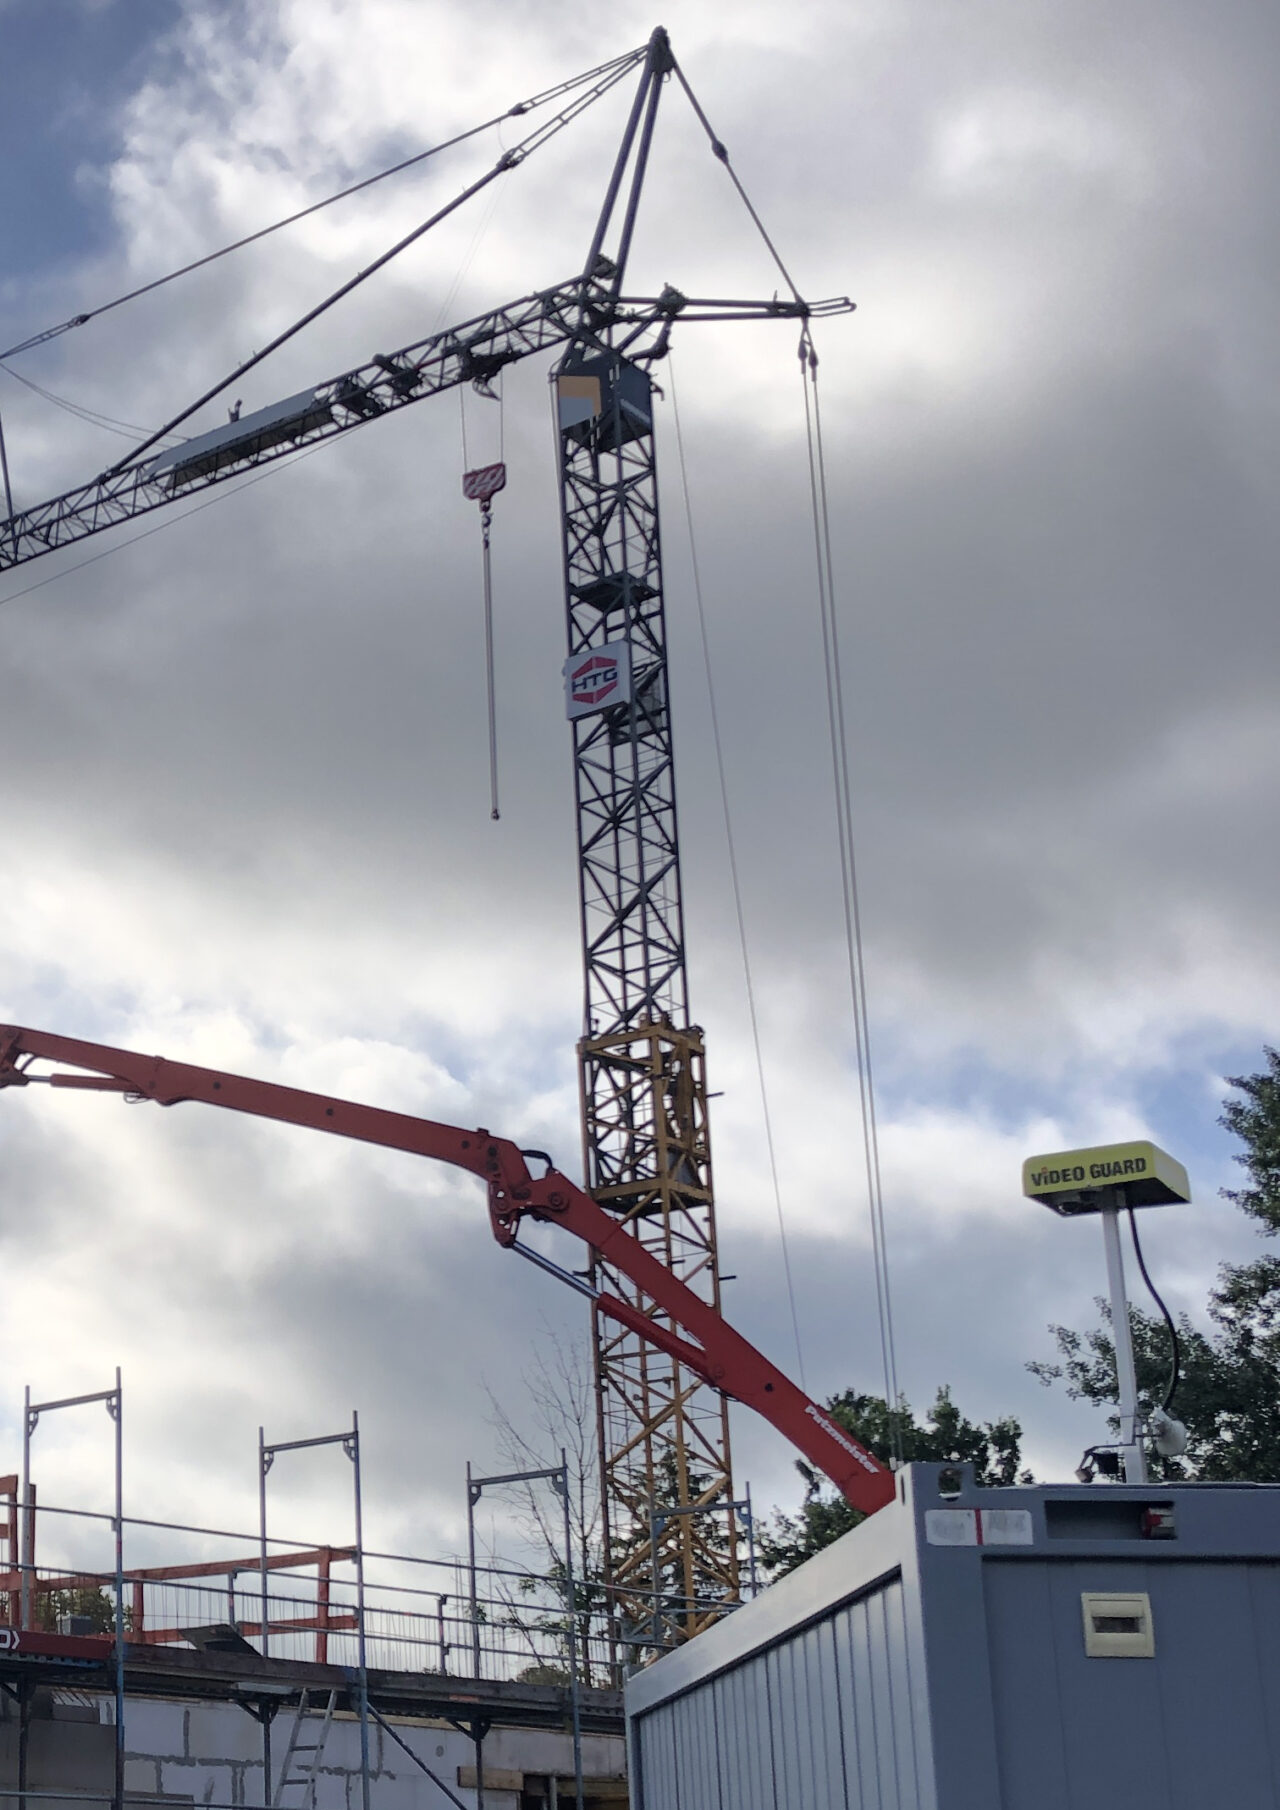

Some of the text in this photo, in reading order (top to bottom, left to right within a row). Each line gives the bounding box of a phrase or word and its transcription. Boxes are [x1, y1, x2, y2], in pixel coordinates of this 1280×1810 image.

[572, 667, 618, 693] HTG
[1089, 1157, 1147, 1180] GUARD
[805, 1405, 879, 1474] Putzmeister
